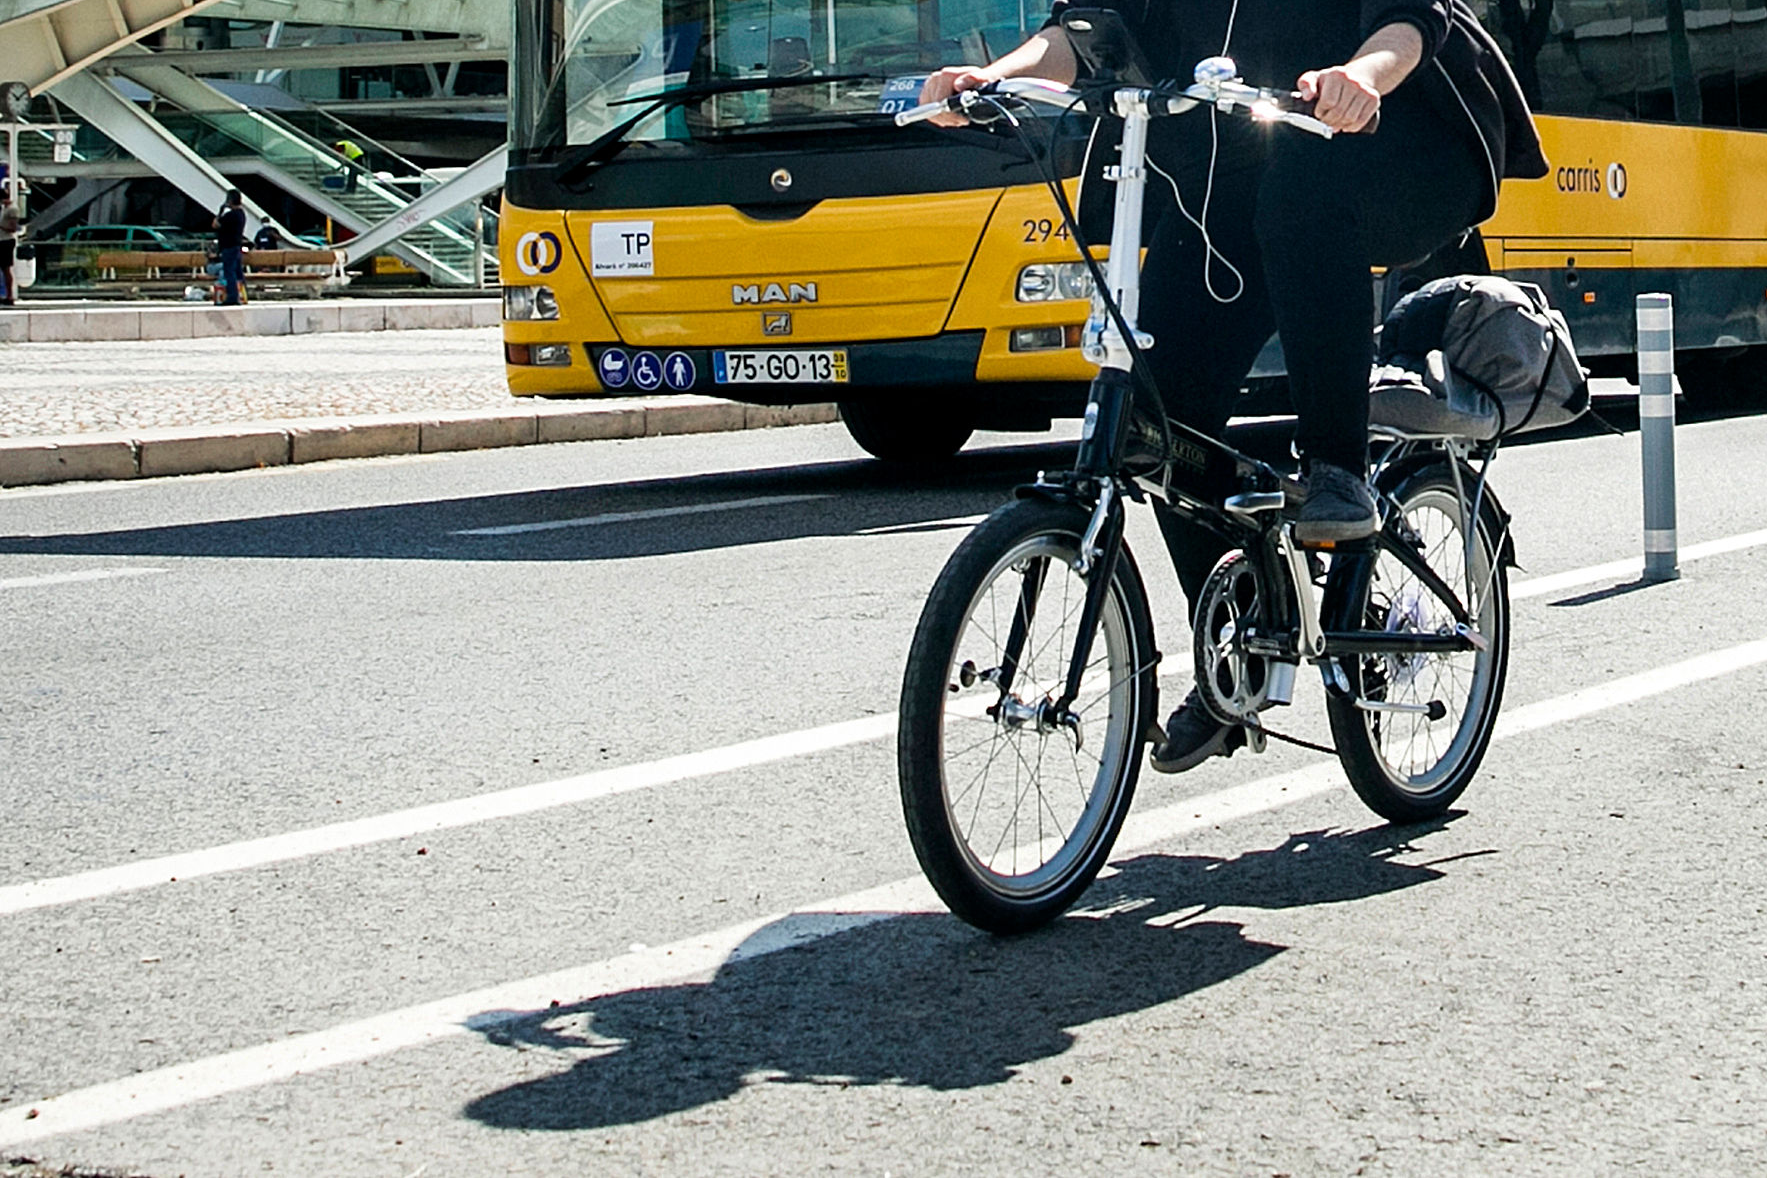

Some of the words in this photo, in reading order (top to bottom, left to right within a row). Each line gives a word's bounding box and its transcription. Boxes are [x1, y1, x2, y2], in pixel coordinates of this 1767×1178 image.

[881, 99, 906, 114] 01
[1557, 158, 1601, 192] carris
[621, 232, 650, 255] TP
[732, 282, 818, 304] MAN
